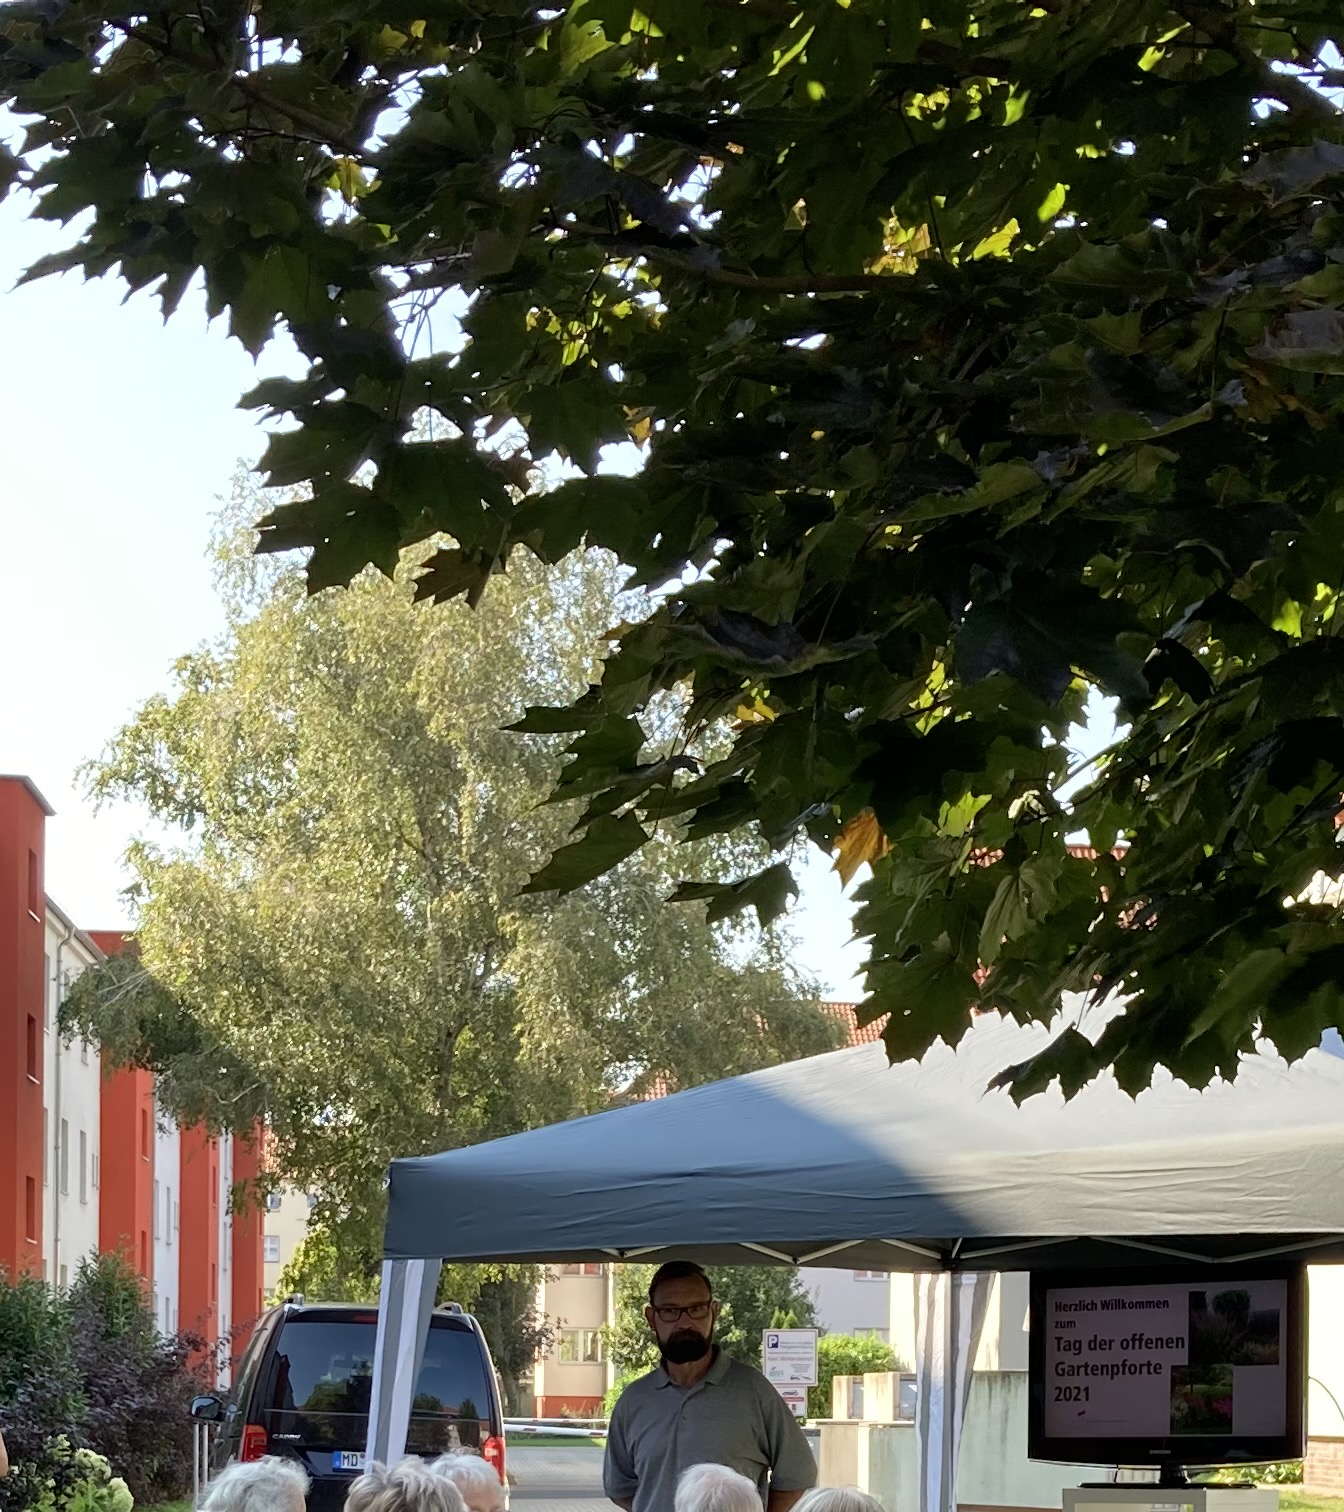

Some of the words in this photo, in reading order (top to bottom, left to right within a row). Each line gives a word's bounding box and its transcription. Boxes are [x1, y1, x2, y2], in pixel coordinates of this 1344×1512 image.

[1054, 1300, 1098, 1313] Herzlich
[1100, 1299, 1170, 1311] Willkommen
[1054, 1320, 1077, 1329] zum
[1054, 1336, 1083, 1356] Tag
[1087, 1334, 1115, 1351] der
[1119, 1332, 1186, 1351] offenen
[1054, 1359, 1163, 1381] Gartenpforte
[1054, 1386, 1090, 1402] 2021
